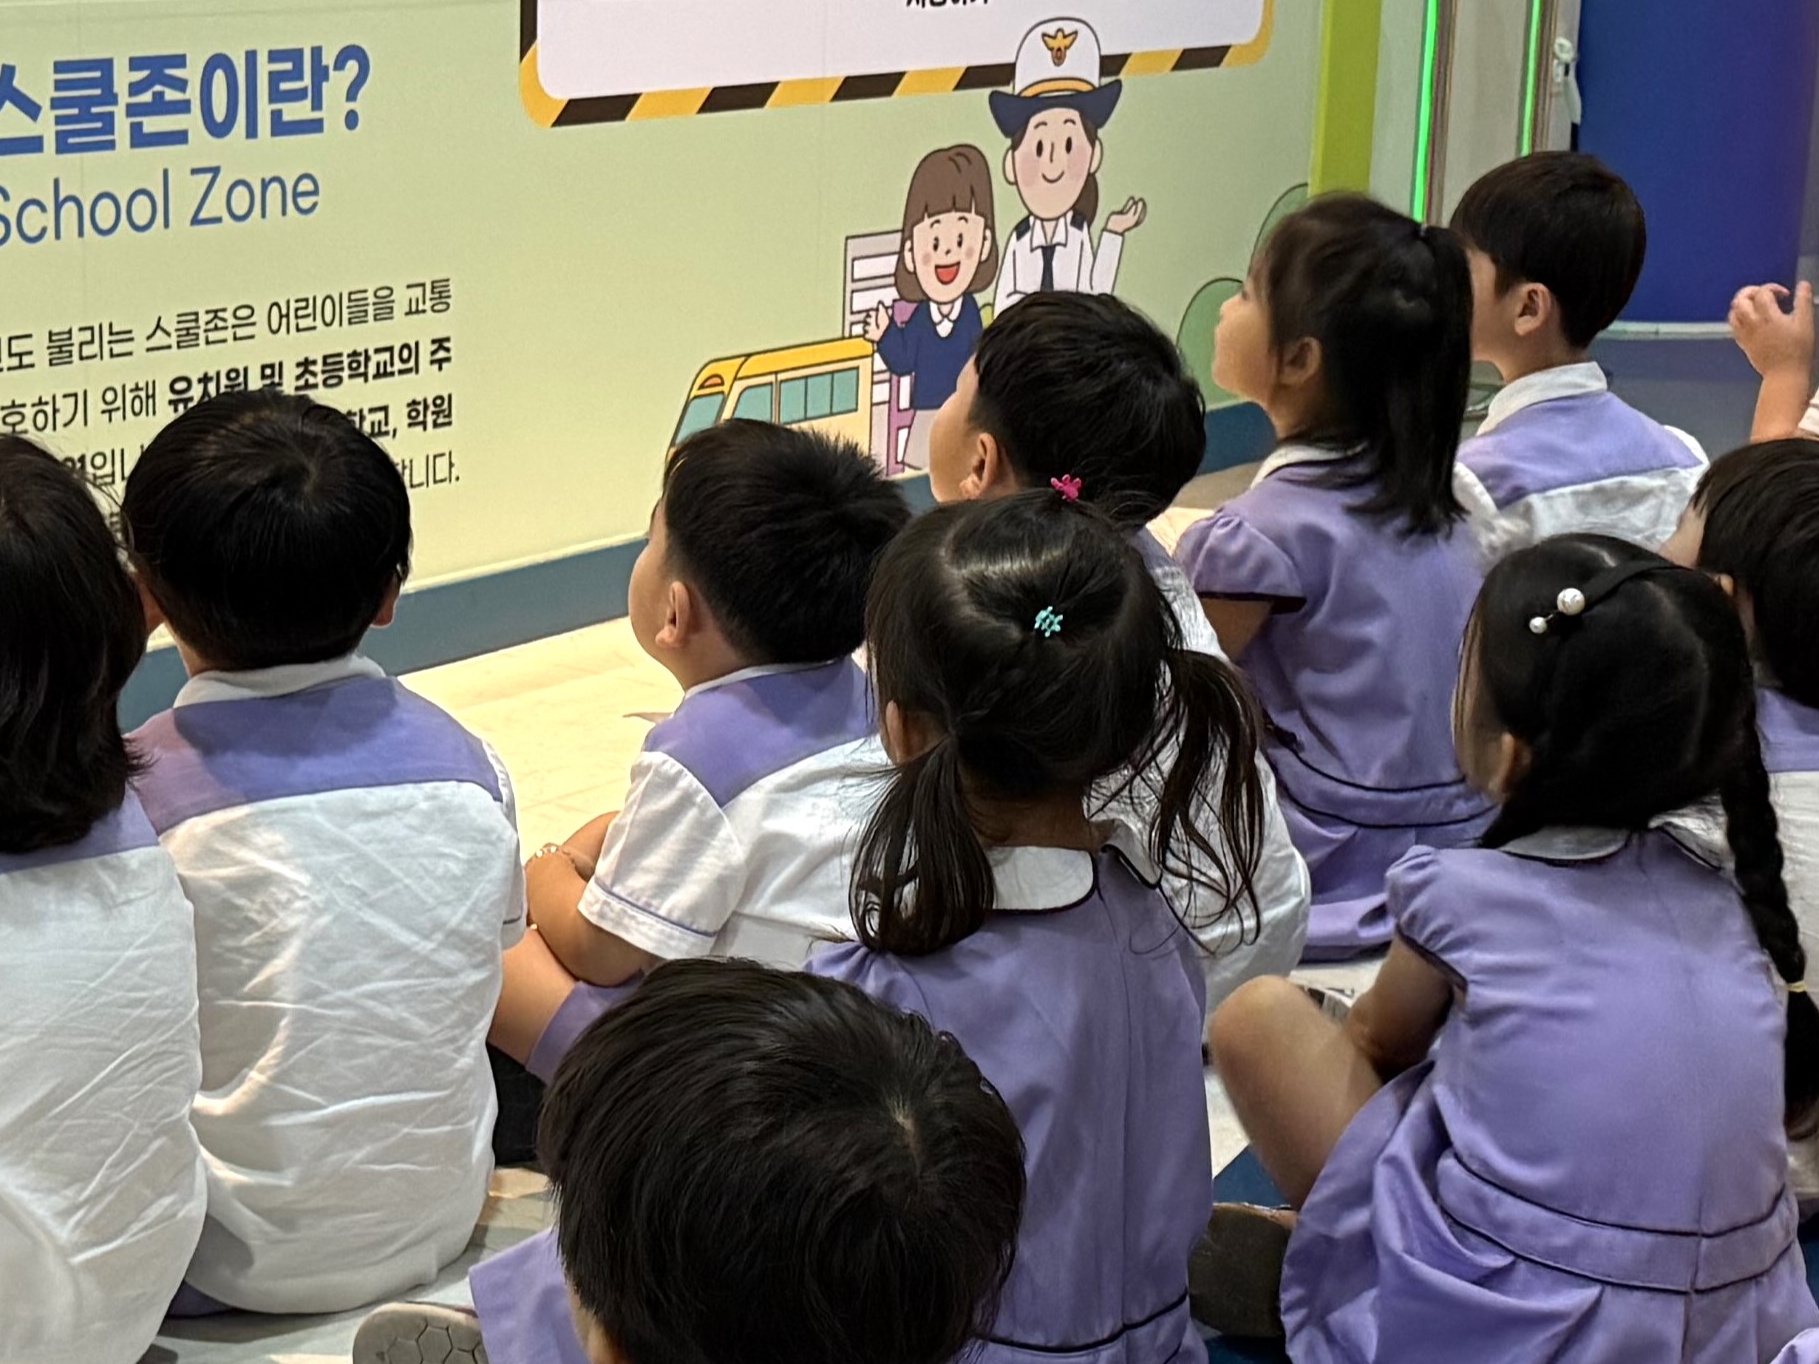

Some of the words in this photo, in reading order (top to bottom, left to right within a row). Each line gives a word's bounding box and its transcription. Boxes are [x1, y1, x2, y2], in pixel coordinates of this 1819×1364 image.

[188, 165, 321, 227] Zone
[46, 321, 134, 368] 불리는
[145, 303, 257, 355] 스쿨존은
[267, 286, 396, 337] 어린이들을
[404, 278, 452, 319] 교통
[100, 379, 157, 425] 위해
[294, 340, 420, 395] 초등학교의
[430, 336, 453, 373] 주
[406, 392, 453, 433] 학원
